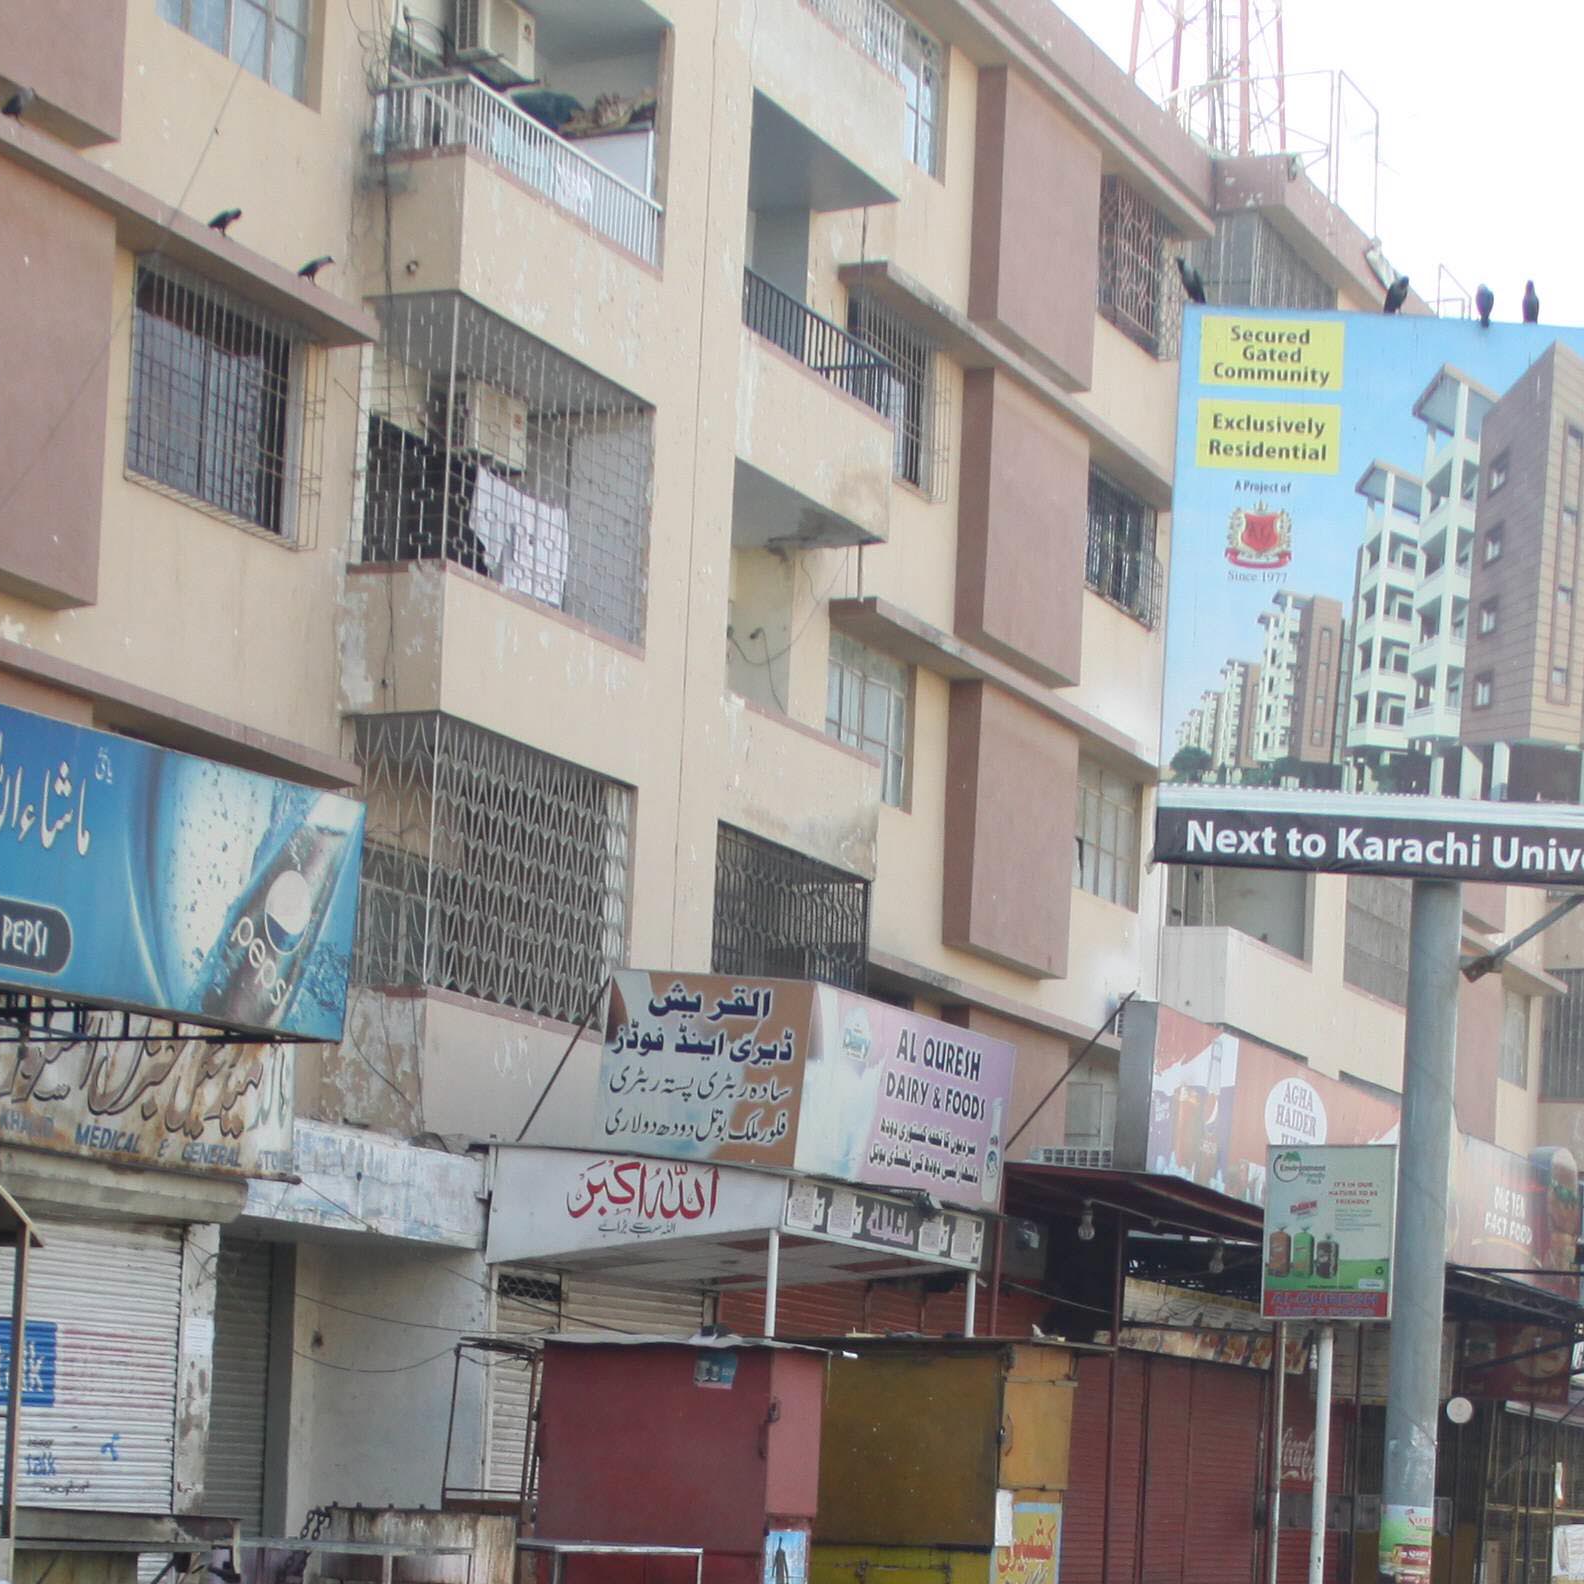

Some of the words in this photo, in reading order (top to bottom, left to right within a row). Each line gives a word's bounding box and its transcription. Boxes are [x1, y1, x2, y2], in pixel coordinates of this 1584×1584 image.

[1231, 326, 1310, 345] Secured
[1243, 346, 1302, 364] Gated
[1213, 362, 1330, 387] Community
[1213, 413, 1325, 438] Exclusively
[1209, 439, 1327, 462] Residential
[1234, 480, 1242, 491] A
[1244, 481, 1276, 495] Project
[1280, 483, 1291, 494] of
[1227, 570, 1258, 583] Since
[1261, 572, 1288, 584] 1977
[1185, 820, 1277, 857] Next
[1289, 825, 1328, 858] to
[1337, 824, 1481, 870] Karachi
[2, 914, 49, 958] PEPSI
[229, 916, 293, 1006] pepsi
[611, 1018, 664, 1056] فوڈز
[674, 1022, 725, 1060] اینڈ
[729, 1028, 793, 1065] ڈیری
[896, 1028, 917, 1063] AL
[923, 1036, 982, 1082] QURESH
[885, 1071, 930, 1106] DAIRY
[932, 1086, 941, 1110] &
[944, 1088, 988, 1121] FOODS
[1282, 1081, 1314, 1113] AGHA
[1275, 1104, 1317, 1139] HAIDER
[75, 1122, 143, 1155] MEDICAL
[181, 1141, 243, 1168] GENERAL
